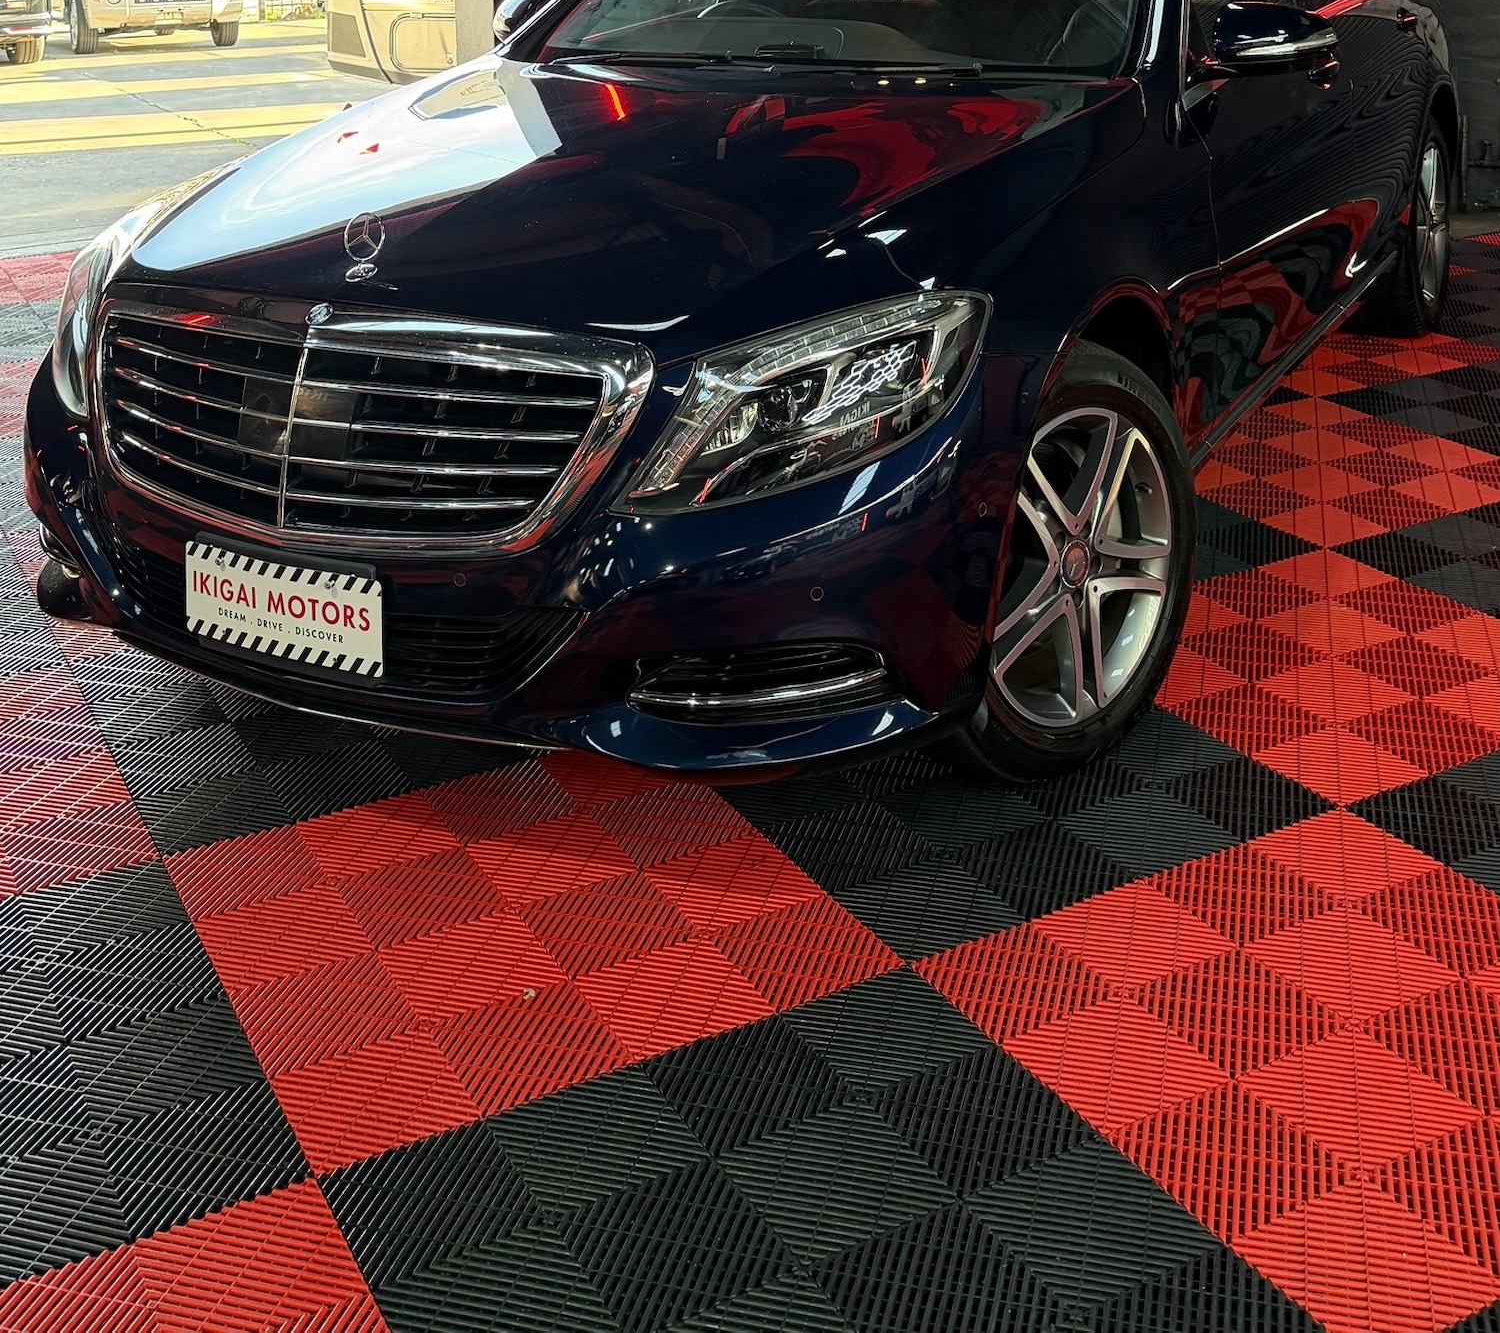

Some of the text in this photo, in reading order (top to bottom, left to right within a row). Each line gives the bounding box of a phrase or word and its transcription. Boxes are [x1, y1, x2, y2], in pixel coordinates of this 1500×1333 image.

[192, 570, 371, 631] IKIGAI MOTORS
[218, 607, 344, 644] DREAM DRIVE DISCOVER
